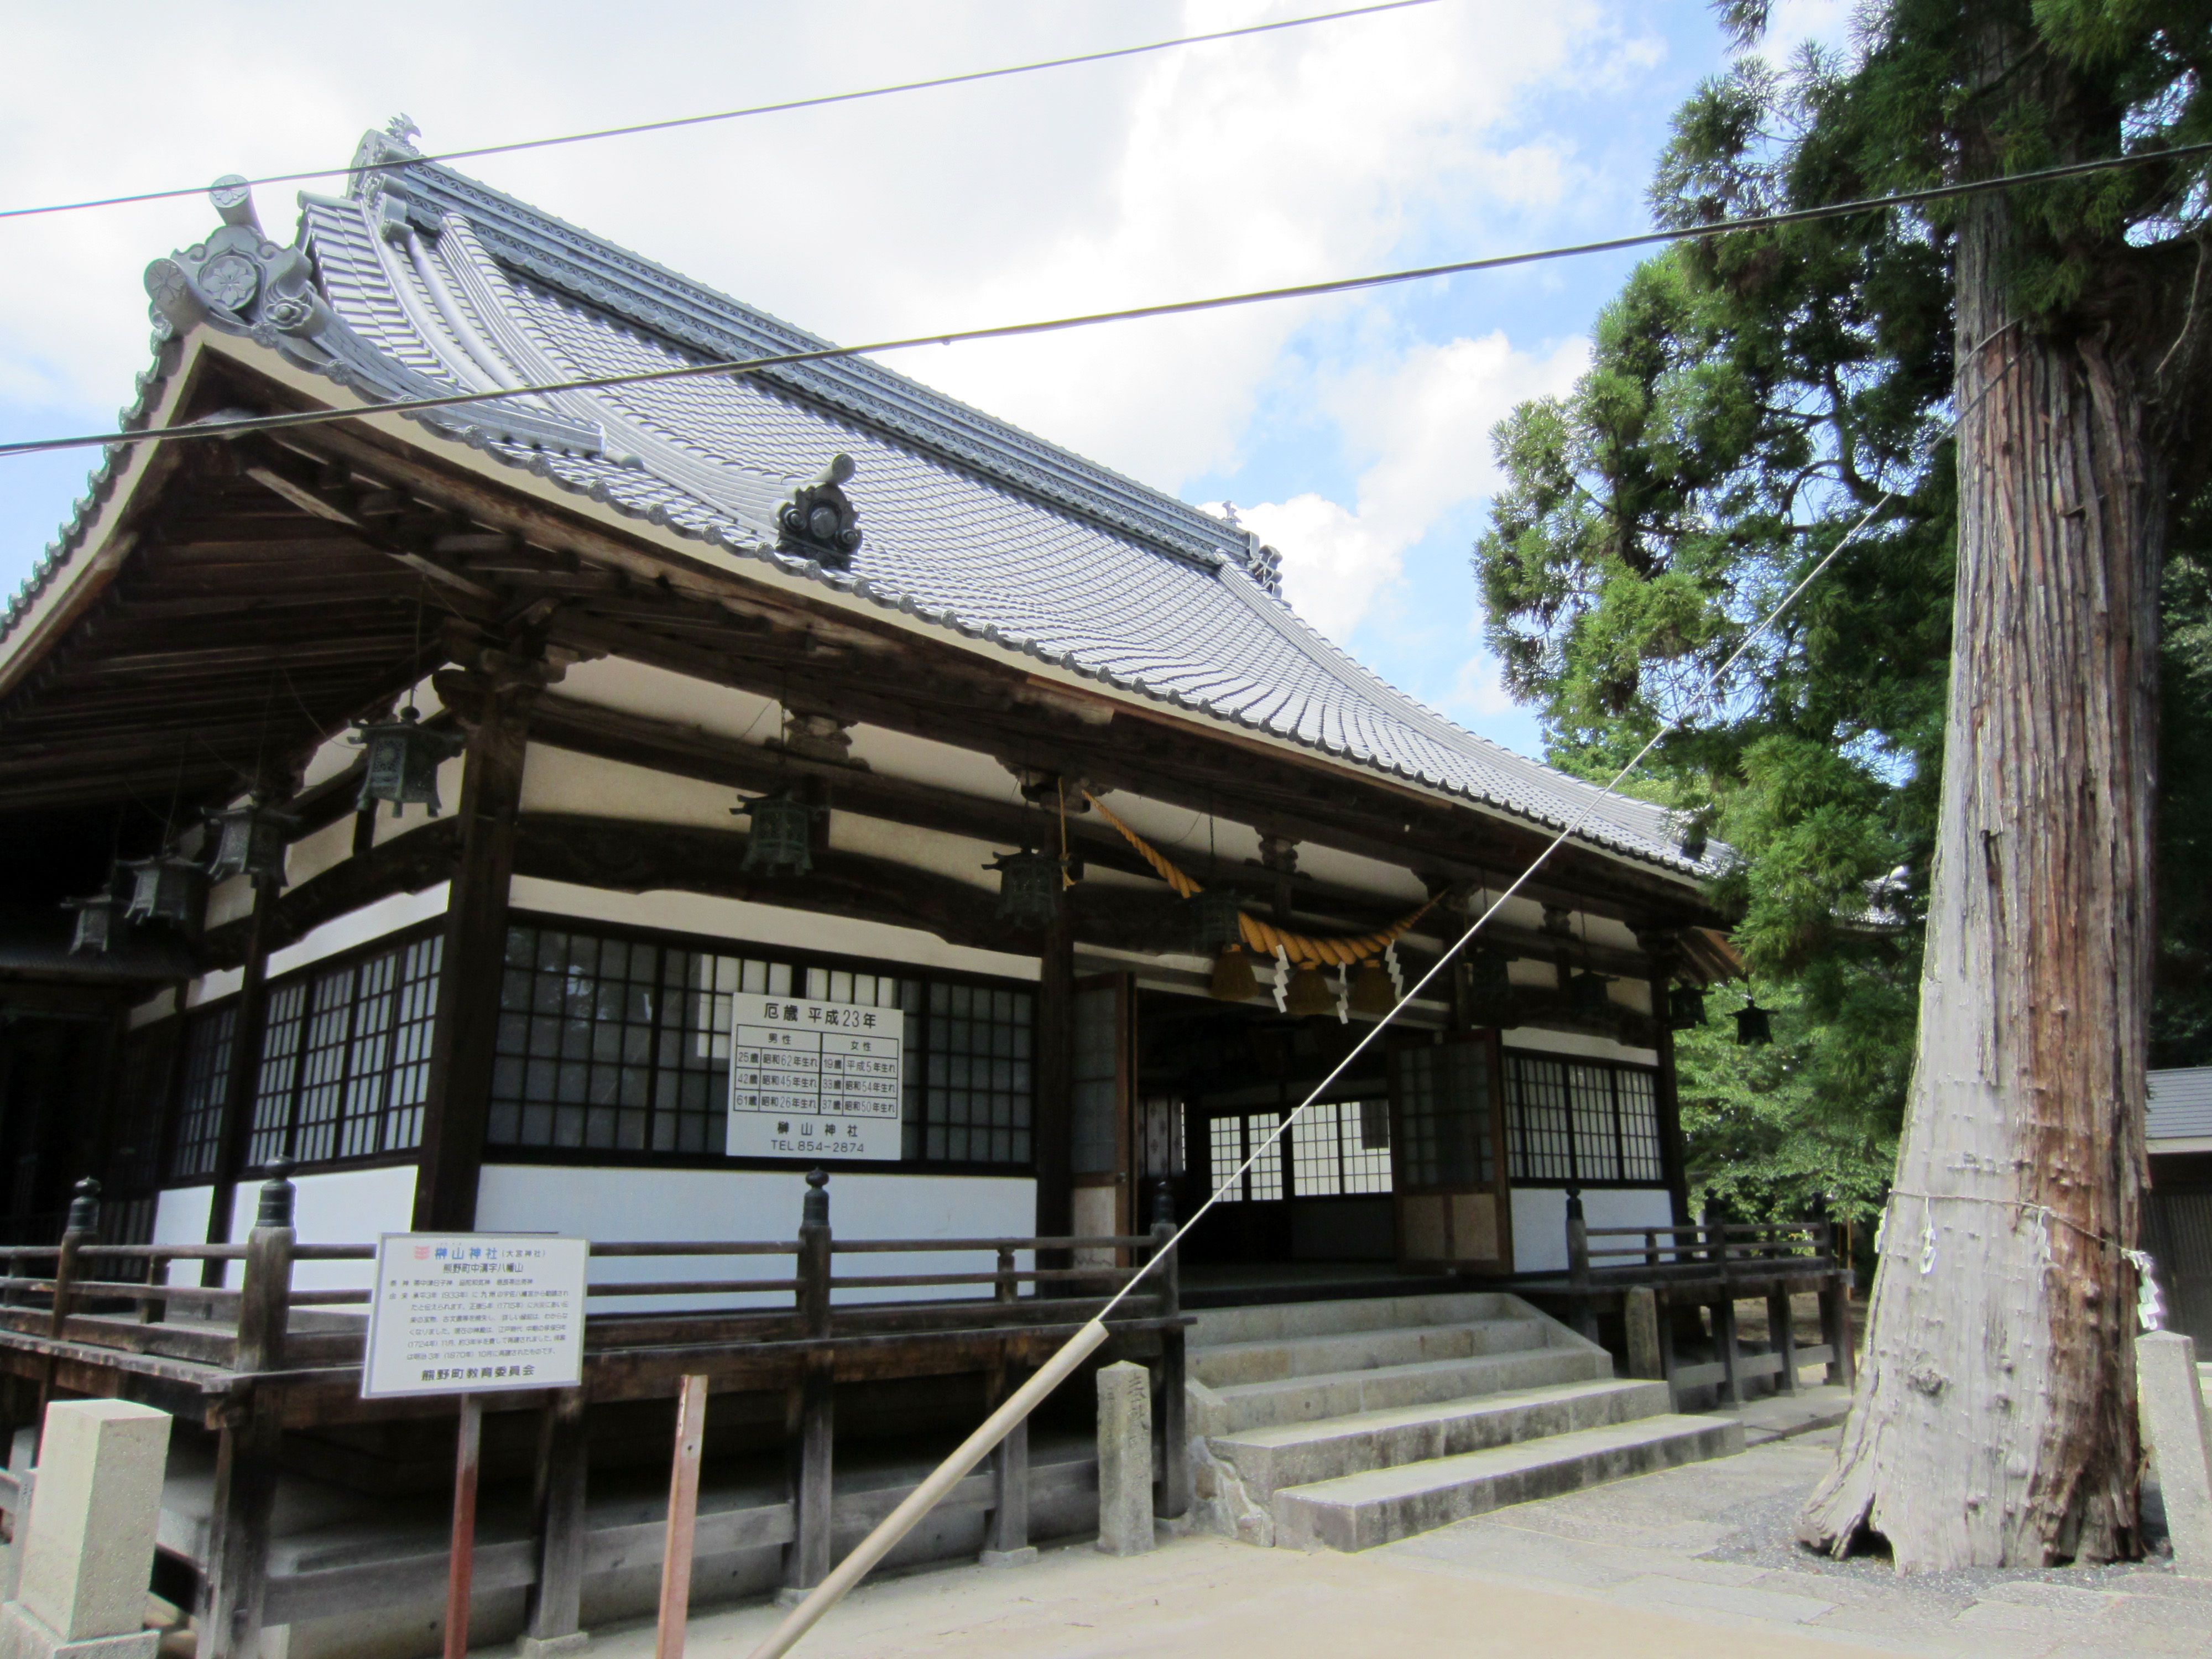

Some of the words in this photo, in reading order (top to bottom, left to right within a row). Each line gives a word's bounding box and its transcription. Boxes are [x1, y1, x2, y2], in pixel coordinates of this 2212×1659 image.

[808, 1007, 876, 1029] 平成23年
[768, 1033, 791, 1045] 男性
[851, 1041, 872, 1051] 女性
[738, 1052, 758, 1064] 25歳
[763, 1053, 818, 1068] 昭和62年生れ
[824, 1058, 843, 1070] 19歳
[847, 1060, 896, 1073] 平成5年生れ
[738, 1073, 758, 1084] 42歳
[762, 1074, 817, 1088] 昭和45年生れ
[846, 1080, 896, 1093] 昭和54年生れ
[737, 1094, 757, 1106] 61歳
[761, 1095, 816, 1109] 昭和26年生れ
[822, 1098, 841, 1110] 37歳
[845, 1100, 895, 1113] 昭和50年生れ
[771, 1140, 794, 1151] TEL
[798, 1141, 864, 1152] 854-2874
[421, 1365, 534, 1381] 熊野町教育委員会
